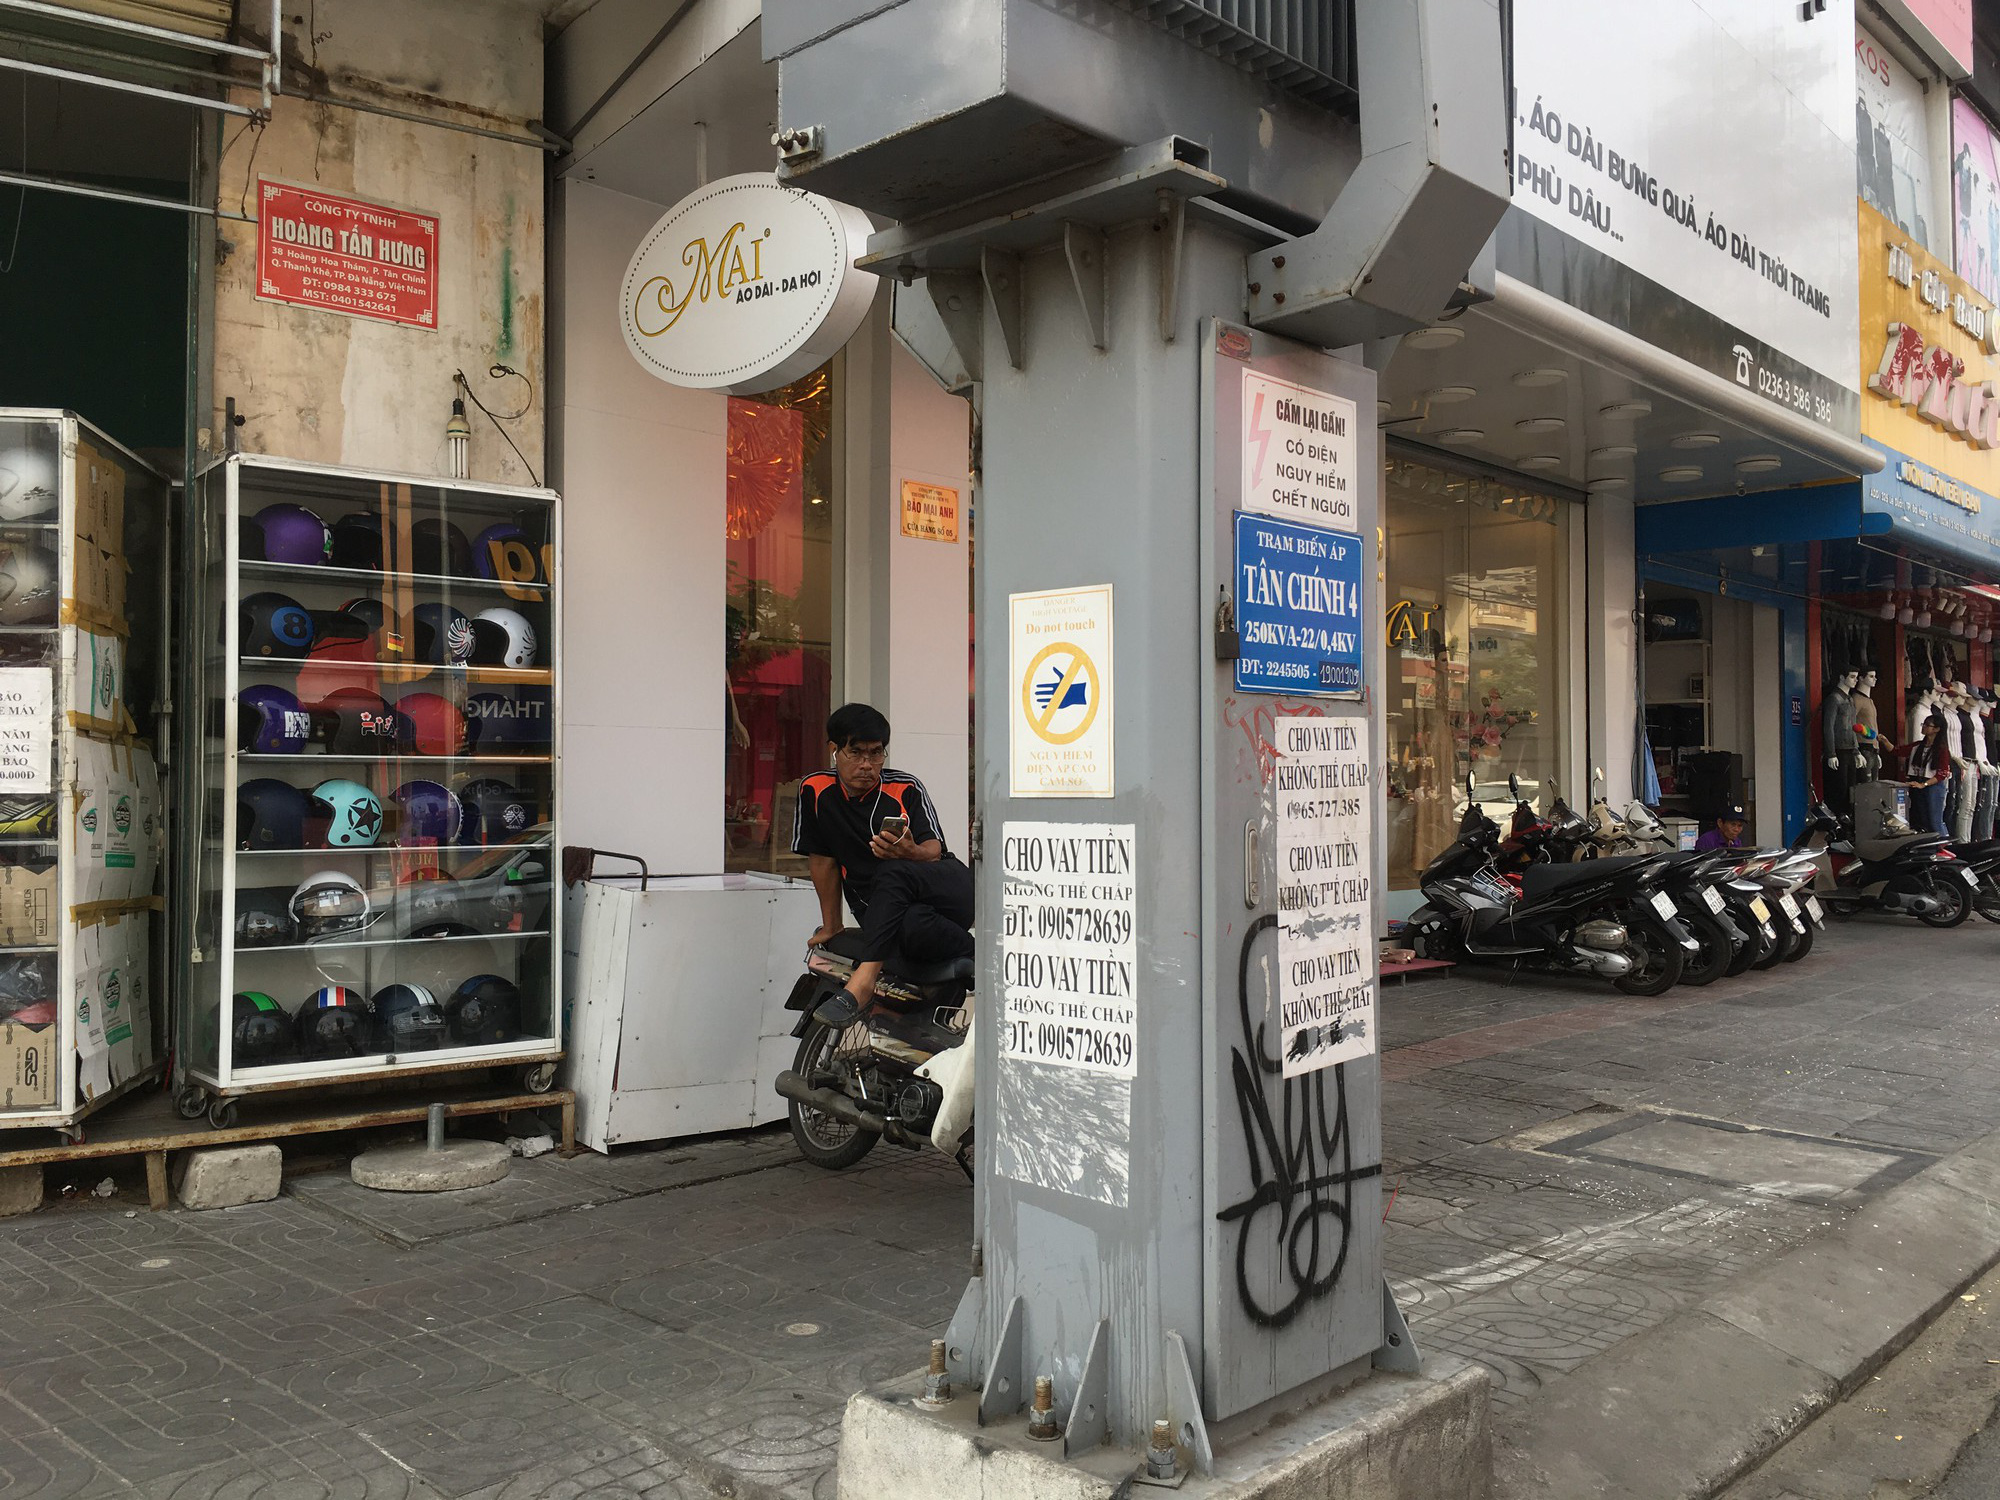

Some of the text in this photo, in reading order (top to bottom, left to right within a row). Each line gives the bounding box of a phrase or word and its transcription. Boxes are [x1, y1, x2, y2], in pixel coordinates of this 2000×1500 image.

[1518, 154, 1562, 206] PHÙ
[305, 201, 396, 228] CÔNG TY TNHH
[1529, 95, 1562, 144] ÁO
[1568, 126, 1602, 172] DÀI
[1608, 149, 1658, 207] BƯNG
[1705, 212, 1727, 251] ÁO
[1731, 234, 1756, 271] DÀI
[1759, 250, 1788, 291] THỜI
[1790, 272, 1830, 318] TRANG
[272, 216, 425, 269] HOÀNG TẤN HƯNG
[271, 258, 426, 296] Q. Thanh Khê, TP. Đà Nẵng, Việt Nam
[272, 246, 427, 285] 38 Hoàng Hoa Thám, P. Tân Chính
[800, 270, 821, 289] HỘI
[302, 277, 397, 302] ĐT: 0984 333 675
[302, 288, 397, 313] MST: 0401542641
[1276, 399, 1345, 437] CẤM LẠI GẦN!
[1793, 385, 1811, 412] 586
[1815, 396, 1832, 422] 586
[1286, 439, 1337, 464] CÓ ĐIỆN
[1276, 463, 1346, 491] NGUY HIỂM
[939, 506, 953, 519] ANH
[1272, 488, 1350, 517] CHẾT NGƯỜI
[1256, 531, 1346, 561] TRẠM BIẾN ÁP
[1044, 597, 1076, 606] DANGER
[1243, 556, 1358, 617] TÂN CHÍNH 4
[1025, 618, 1095, 634] Do not touch
[1245, 620, 1356, 655] 250KVA-22/0,4KV
[1241, 658, 1263, 675] ĐT:
[1266, 661, 1310, 679] 2245505
[9, 703, 36, 715] MÁY
[0, 743, 30, 755] ẶNG
[3, 729, 30, 740] NĂM
[1288, 720, 1357, 752] CHO VAY TIỀN
[1030, 751, 1058, 760] NGUY
[1071, 763, 1096, 773] CAO
[1278, 758, 1317, 791] KHÔNG
[1004, 828, 1130, 875] CHO VAY TIỀN
[1289, 833, 1358, 873] CHO VAY TIỀN
[1279, 878, 1318, 911] KHÔNG
[1038, 905, 1131, 945] 0905728639
[1004, 949, 1131, 998] CHO VAY TIỀN
[1292, 943, 1361, 987] CHO VAY TIỀN
[1009, 995, 1054, 1015] HÔNG
[1283, 992, 1321, 1029] KHÔNG
[1038, 1022, 1132, 1068] 0905728639
[25, 1047, 38, 1086] GRS
